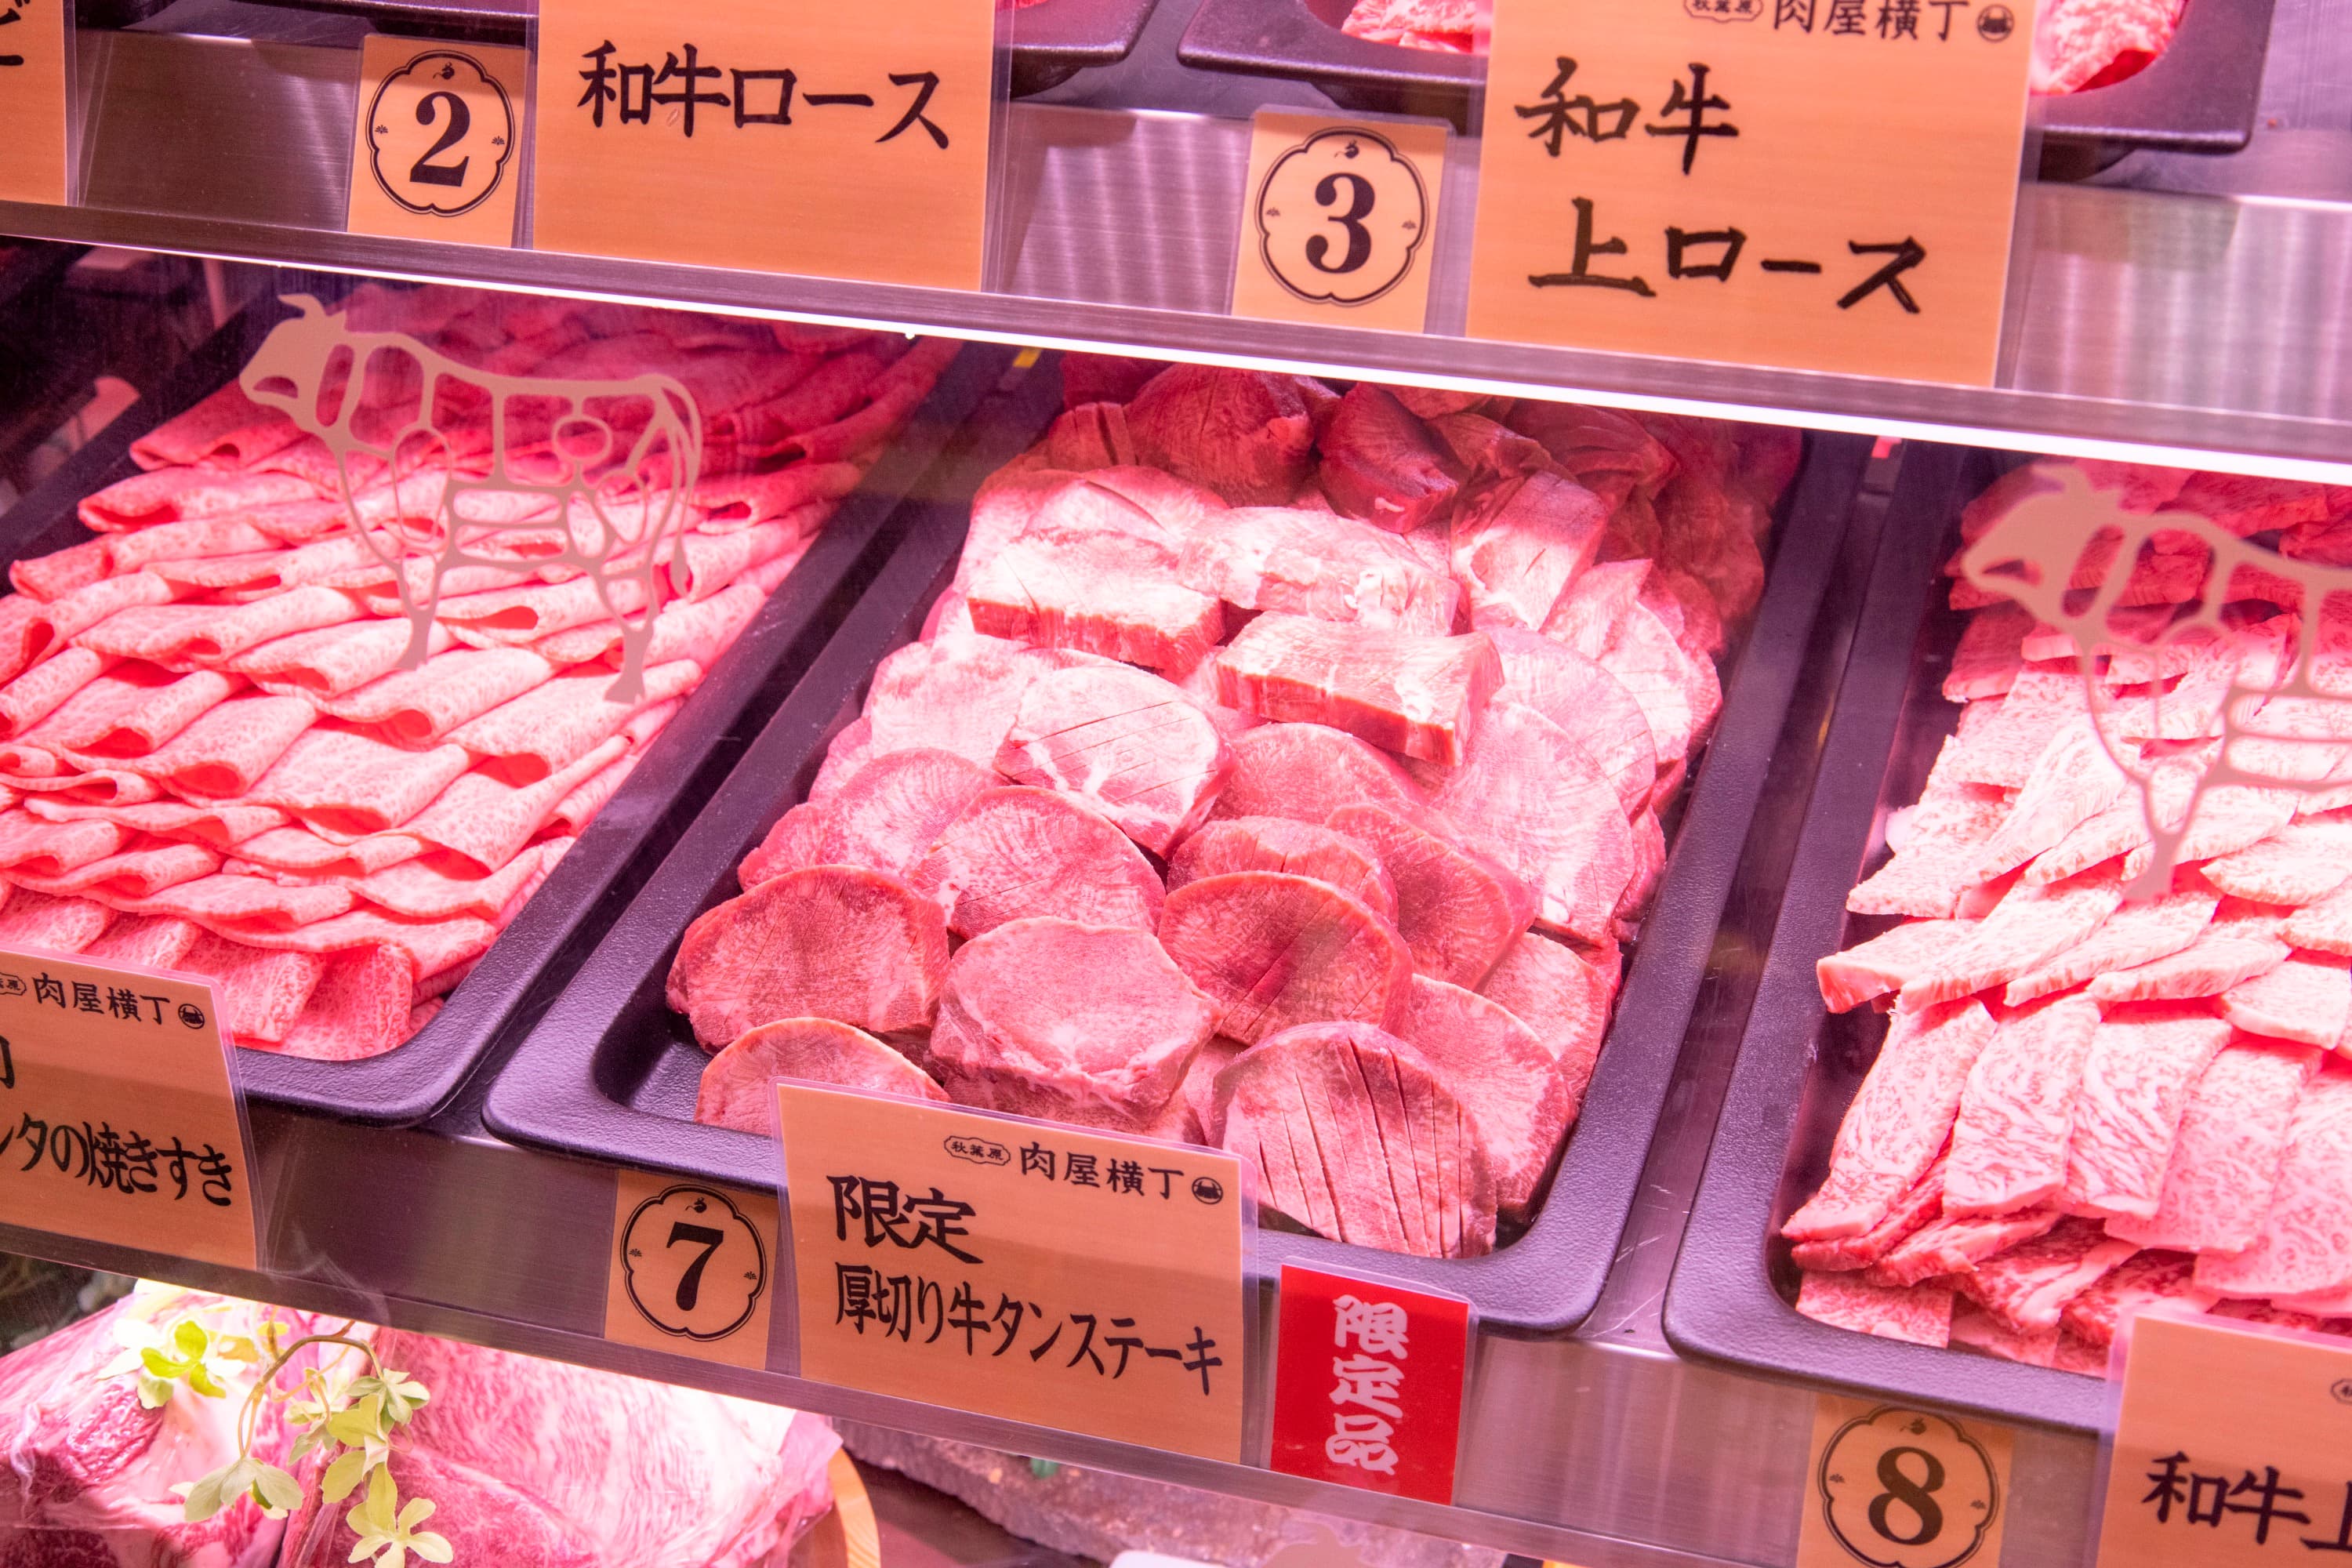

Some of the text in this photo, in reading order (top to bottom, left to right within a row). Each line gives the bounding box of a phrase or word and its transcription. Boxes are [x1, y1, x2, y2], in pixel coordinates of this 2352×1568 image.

[1773, 0, 1970, 42] 肉屋横丁
[409, 90, 470, 187] 2
[577, 39, 950, 150] 和牛ロース
[1515, 56, 1739, 175] 和牛
[1305, 172, 1376, 274] 3
[1527, 196, 1926, 313] 上ロース
[31, 972, 170, 1025] 肉屋横丁
[951, 1140, 1004, 1161] 秋葉原
[1020, 1142, 1185, 1200] 肉屋横丁
[665, 1221, 724, 1312] 7
[826, 1174, 983, 1264] 限定
[834, 1261, 1223, 1396] 厚切り牛タンステーキ
[1325, 1294, 1409, 1475] 限定品
[1868, 1446, 1945, 1546] 8
